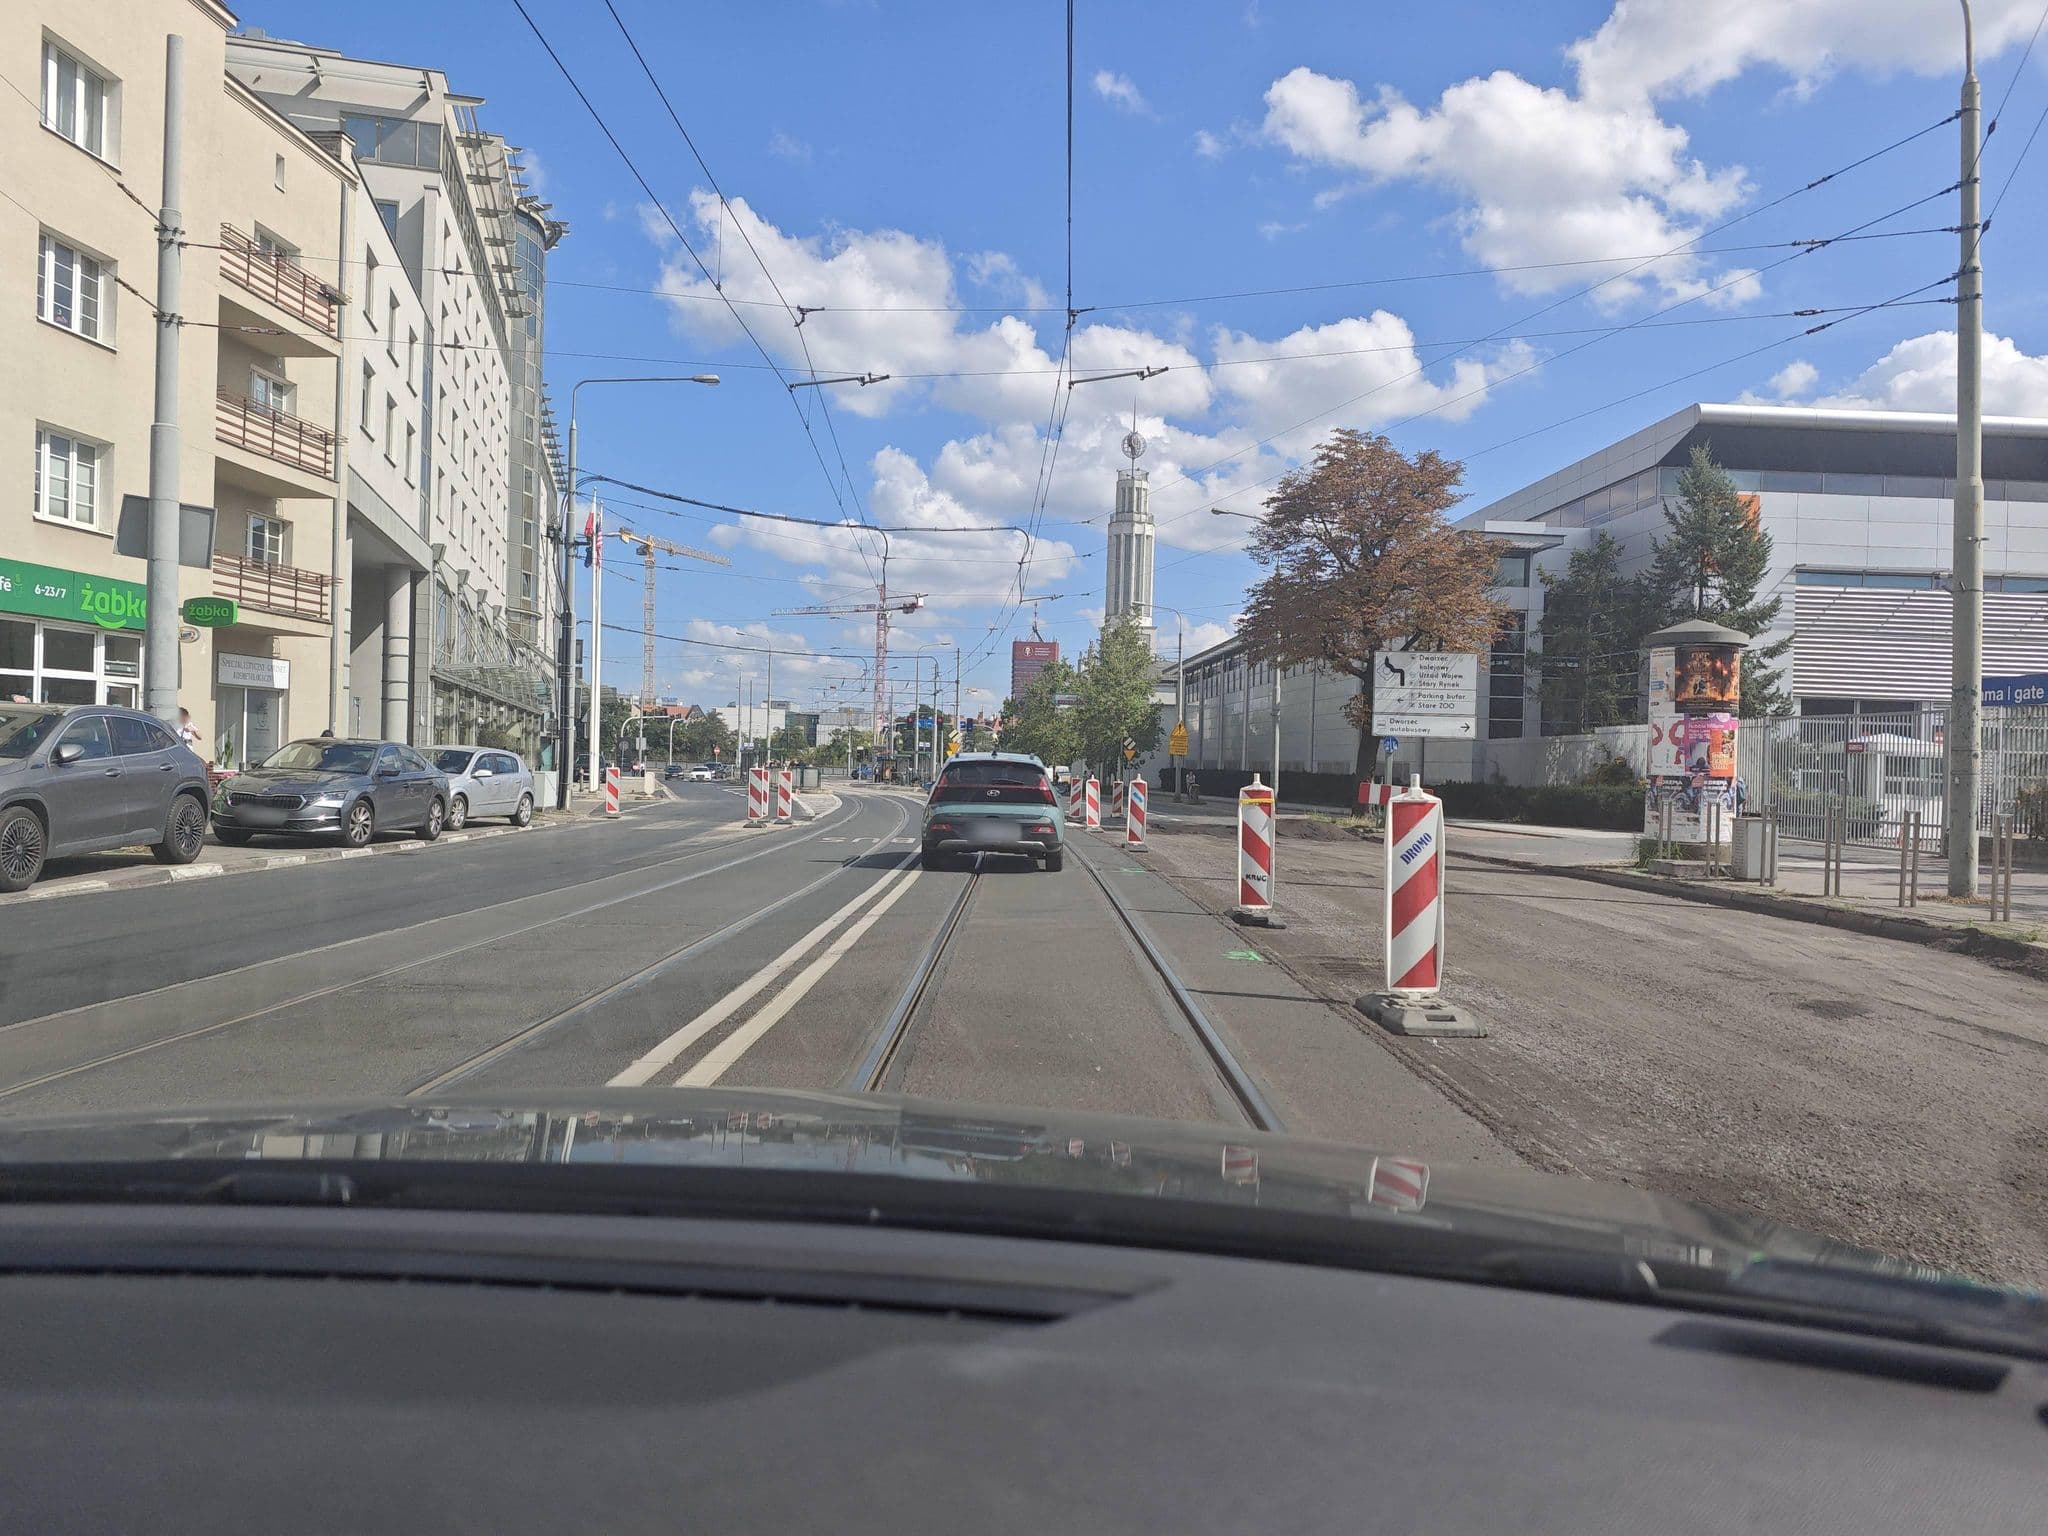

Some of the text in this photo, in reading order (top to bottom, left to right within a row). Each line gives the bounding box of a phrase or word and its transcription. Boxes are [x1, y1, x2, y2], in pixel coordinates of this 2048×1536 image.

[34, 584, 67, 599] 6-23/7
[188, 602, 229, 618] żabka
[1419, 654, 1449, 662] Dworzec
[1419, 663, 1449, 672] kolejowy
[1418, 680, 1437, 688] Stary
[1417, 693, 1444, 701] Parking
[2014, 685, 2045, 704] gate
[1389, 717, 1418, 725] Dworzec
[1389, 726, 1431, 734] autobusowy
[1399, 832, 1433, 866] DROMO
